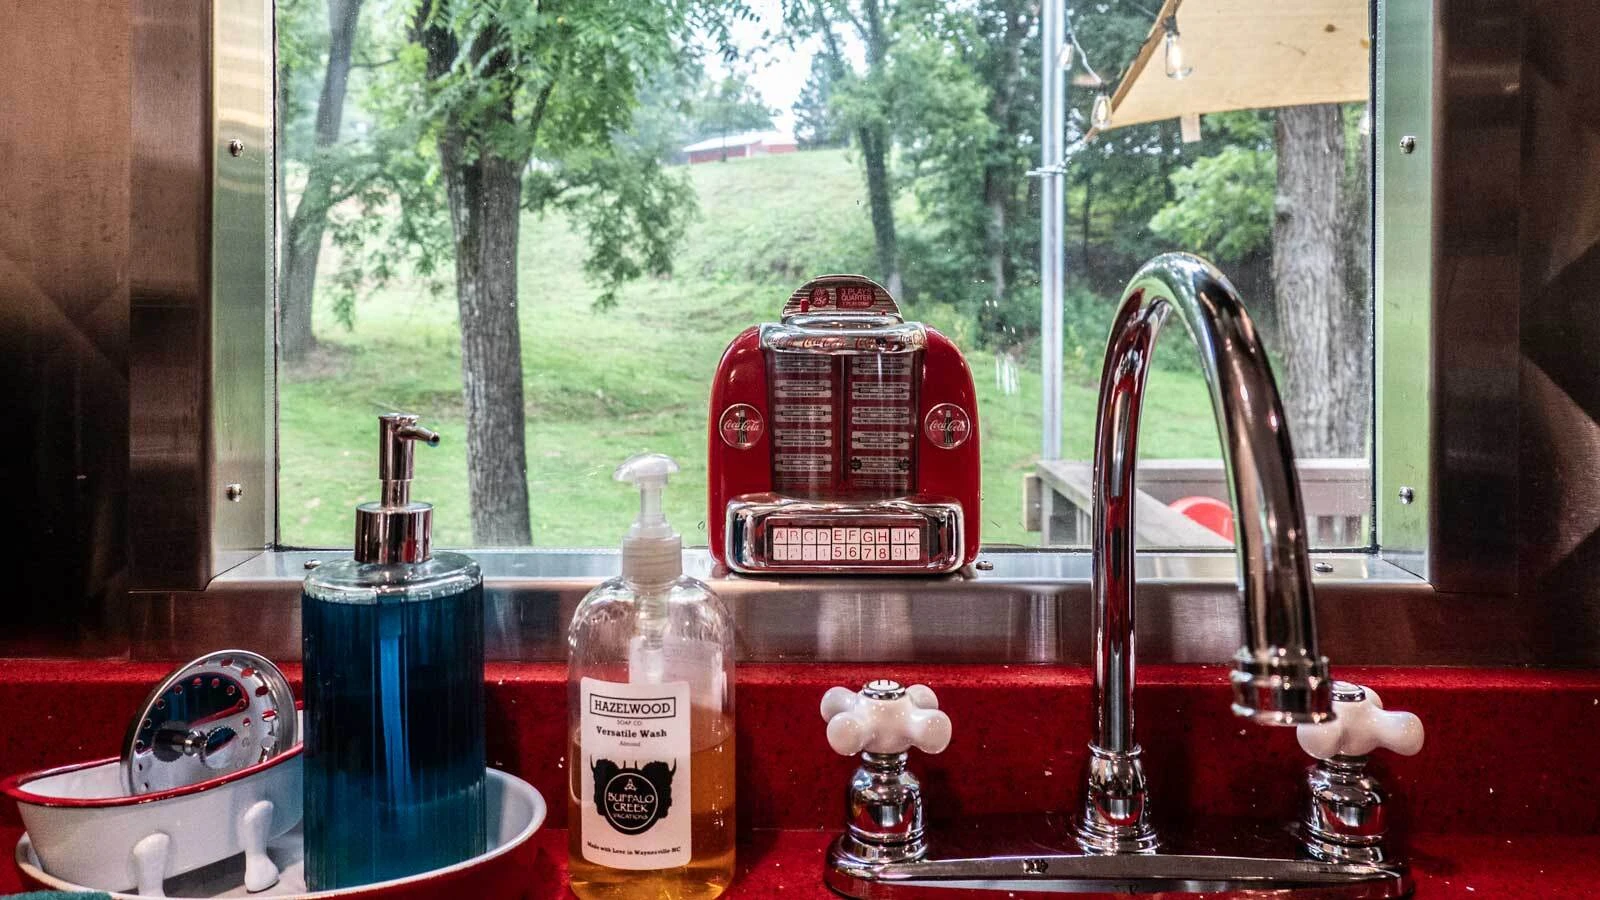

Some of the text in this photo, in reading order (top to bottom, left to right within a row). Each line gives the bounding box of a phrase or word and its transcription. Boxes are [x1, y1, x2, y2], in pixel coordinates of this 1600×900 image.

[834, 529, 843, 541] E
[863, 531, 873, 543] G
[878, 531, 887, 543] H
[595, 700, 671, 714] HAZELWOOD
[596, 725, 667, 738] Versatile Wash
[608, 792, 655, 804] BUFFALO
[613, 802, 649, 813] CREEK
[613, 812, 649, 820] VACATIONS
[587, 841, 600, 850] Made
